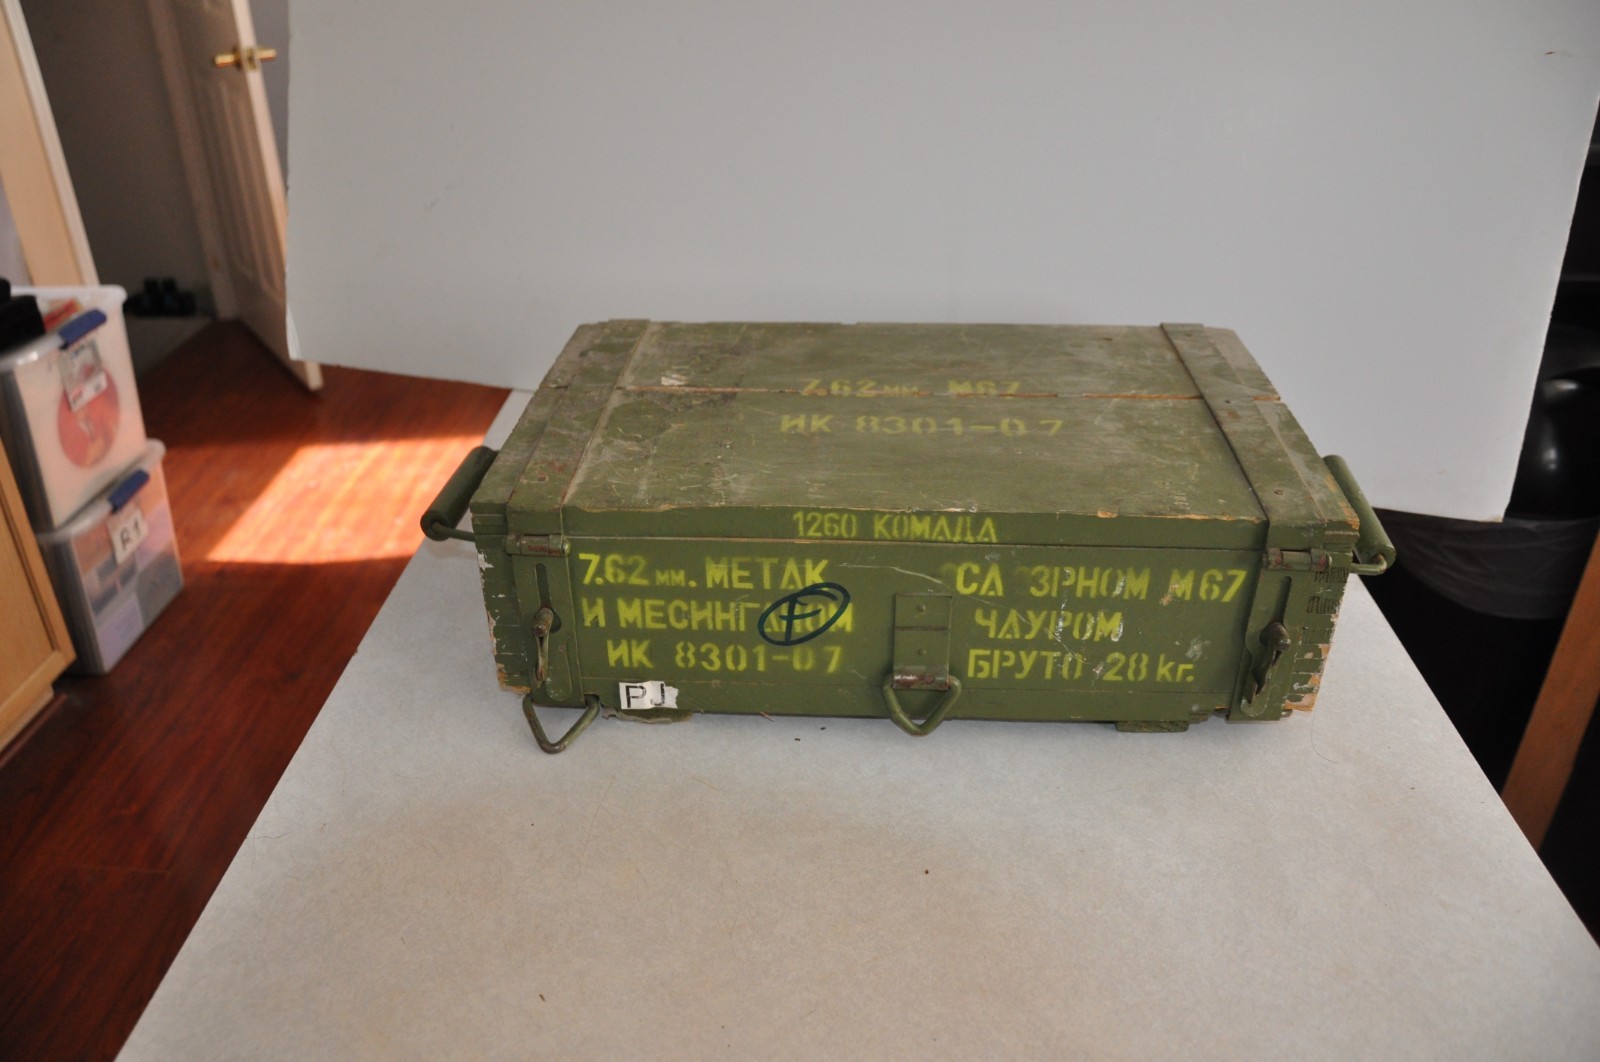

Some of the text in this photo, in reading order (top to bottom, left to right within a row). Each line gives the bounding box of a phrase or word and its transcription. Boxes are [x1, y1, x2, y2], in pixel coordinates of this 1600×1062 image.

[793, 511, 857, 538] 1260
[705, 557, 829, 590] МЕТАК
[956, 562, 1004, 597] СА
[582, 597, 606, 628] И
[967, 648, 1083, 679] БРУТО
[1103, 652, 1147, 681] 28
